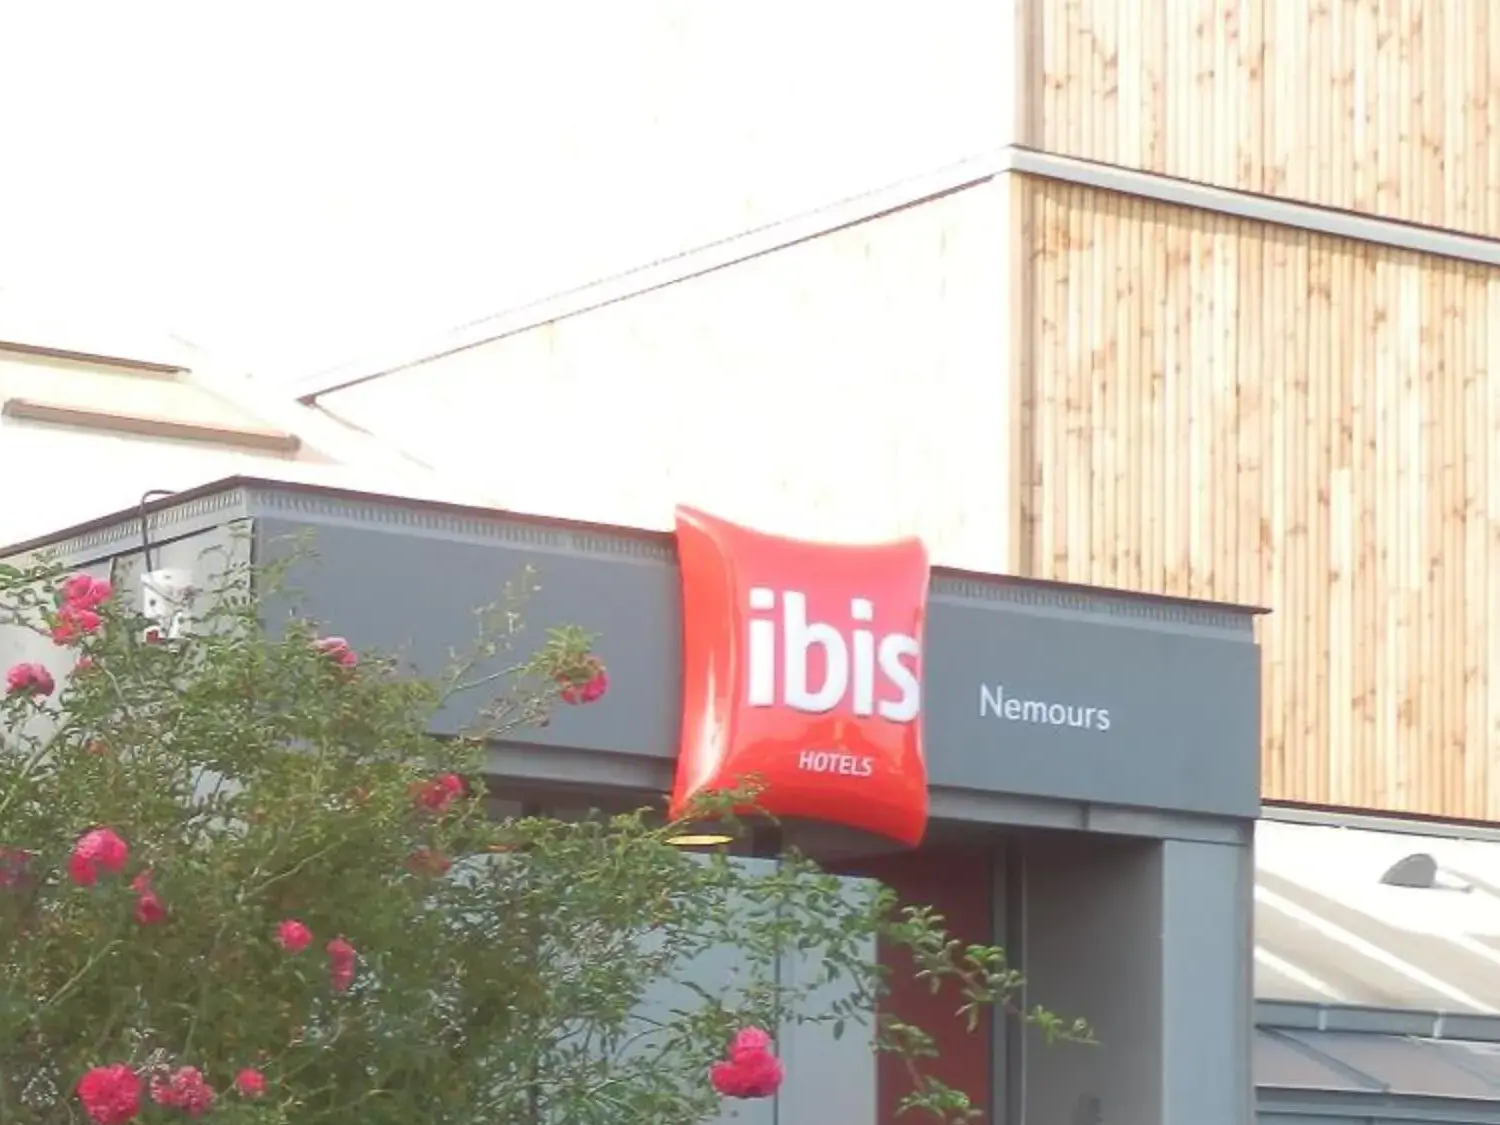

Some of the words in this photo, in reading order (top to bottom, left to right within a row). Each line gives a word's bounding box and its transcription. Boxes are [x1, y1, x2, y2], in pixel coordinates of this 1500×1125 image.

[748, 587, 920, 723] ibis
[979, 682, 1111, 731] Nemours
[799, 750, 873, 777] HOTELS
